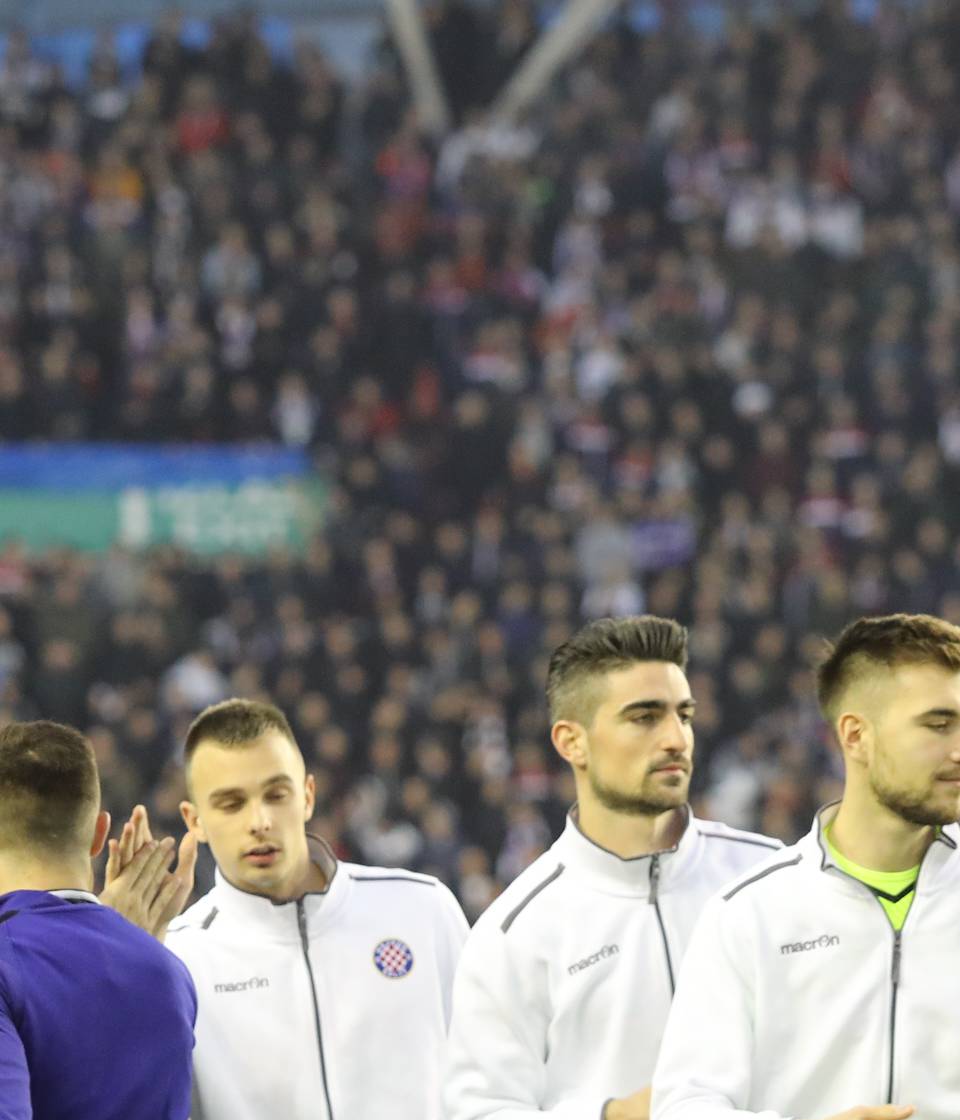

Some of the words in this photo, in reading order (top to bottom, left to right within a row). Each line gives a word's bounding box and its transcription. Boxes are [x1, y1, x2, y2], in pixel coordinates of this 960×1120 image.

[780, 934, 840, 955] macron
[566, 943, 620, 976] macron
[213, 976, 270, 993] macron
